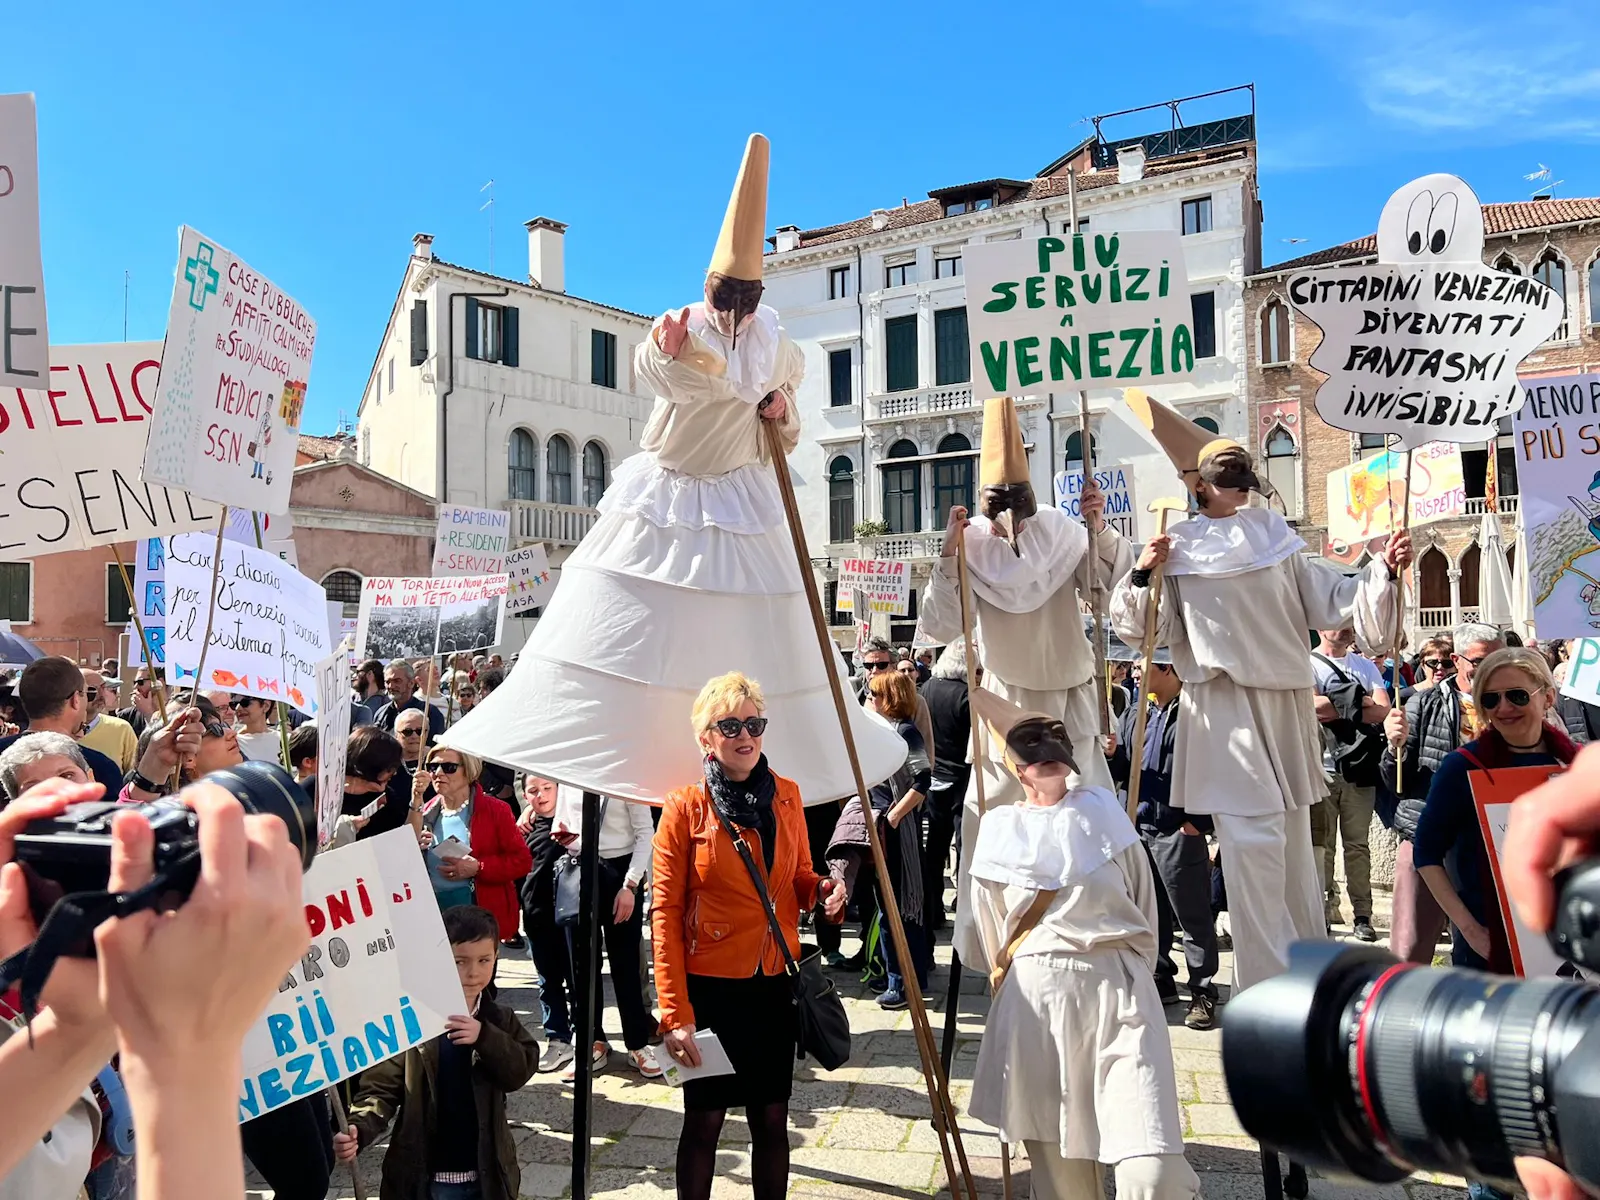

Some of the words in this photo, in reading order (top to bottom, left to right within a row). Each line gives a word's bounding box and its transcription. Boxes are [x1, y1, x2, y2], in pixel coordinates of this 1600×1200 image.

[228, 262, 259, 296] CASE
[261, 282, 313, 339] PUBBLICHE
[1289, 268, 1424, 305] CITTADINI
[1434, 269, 1550, 310] VENEZIANI
[231, 298, 272, 341] AFFITTI
[1059, 313, 1074, 328] A
[1355, 306, 1527, 336] DIVENTATI
[215, 333, 226, 352] PER
[979, 318, 1194, 393] VENEZIA
[1342, 345, 1510, 383] FANTASMI
[215, 372, 262, 421] MEDICI
[204, 423, 242, 466] S.S.N.
[1430, 442, 1455, 459] ESIGE
[1056, 469, 1126, 495] VENSSIA
[1415, 487, 1467, 520] RISPETTO
[452, 508, 506, 528] BAMBINI
[448, 530, 507, 553] RESIDENTI
[447, 553, 502, 574] SERVIZI
[521, 567, 529, 576] DI
[843, 559, 904, 575] VENEZIA
[366, 578, 394, 590] NON
[401, 577, 457, 590] TORNELLI
[170, 585, 201, 615] per
[217, 575, 286, 626] Venezia
[375, 594, 393, 606] MA
[402, 594, 418, 606] UN
[422, 589, 457, 605] TETTO
[460, 588, 480, 602] ALLE
[505, 595, 535, 609] CASA
[170, 606, 194, 642] il
[209, 617, 274, 657] sistema
